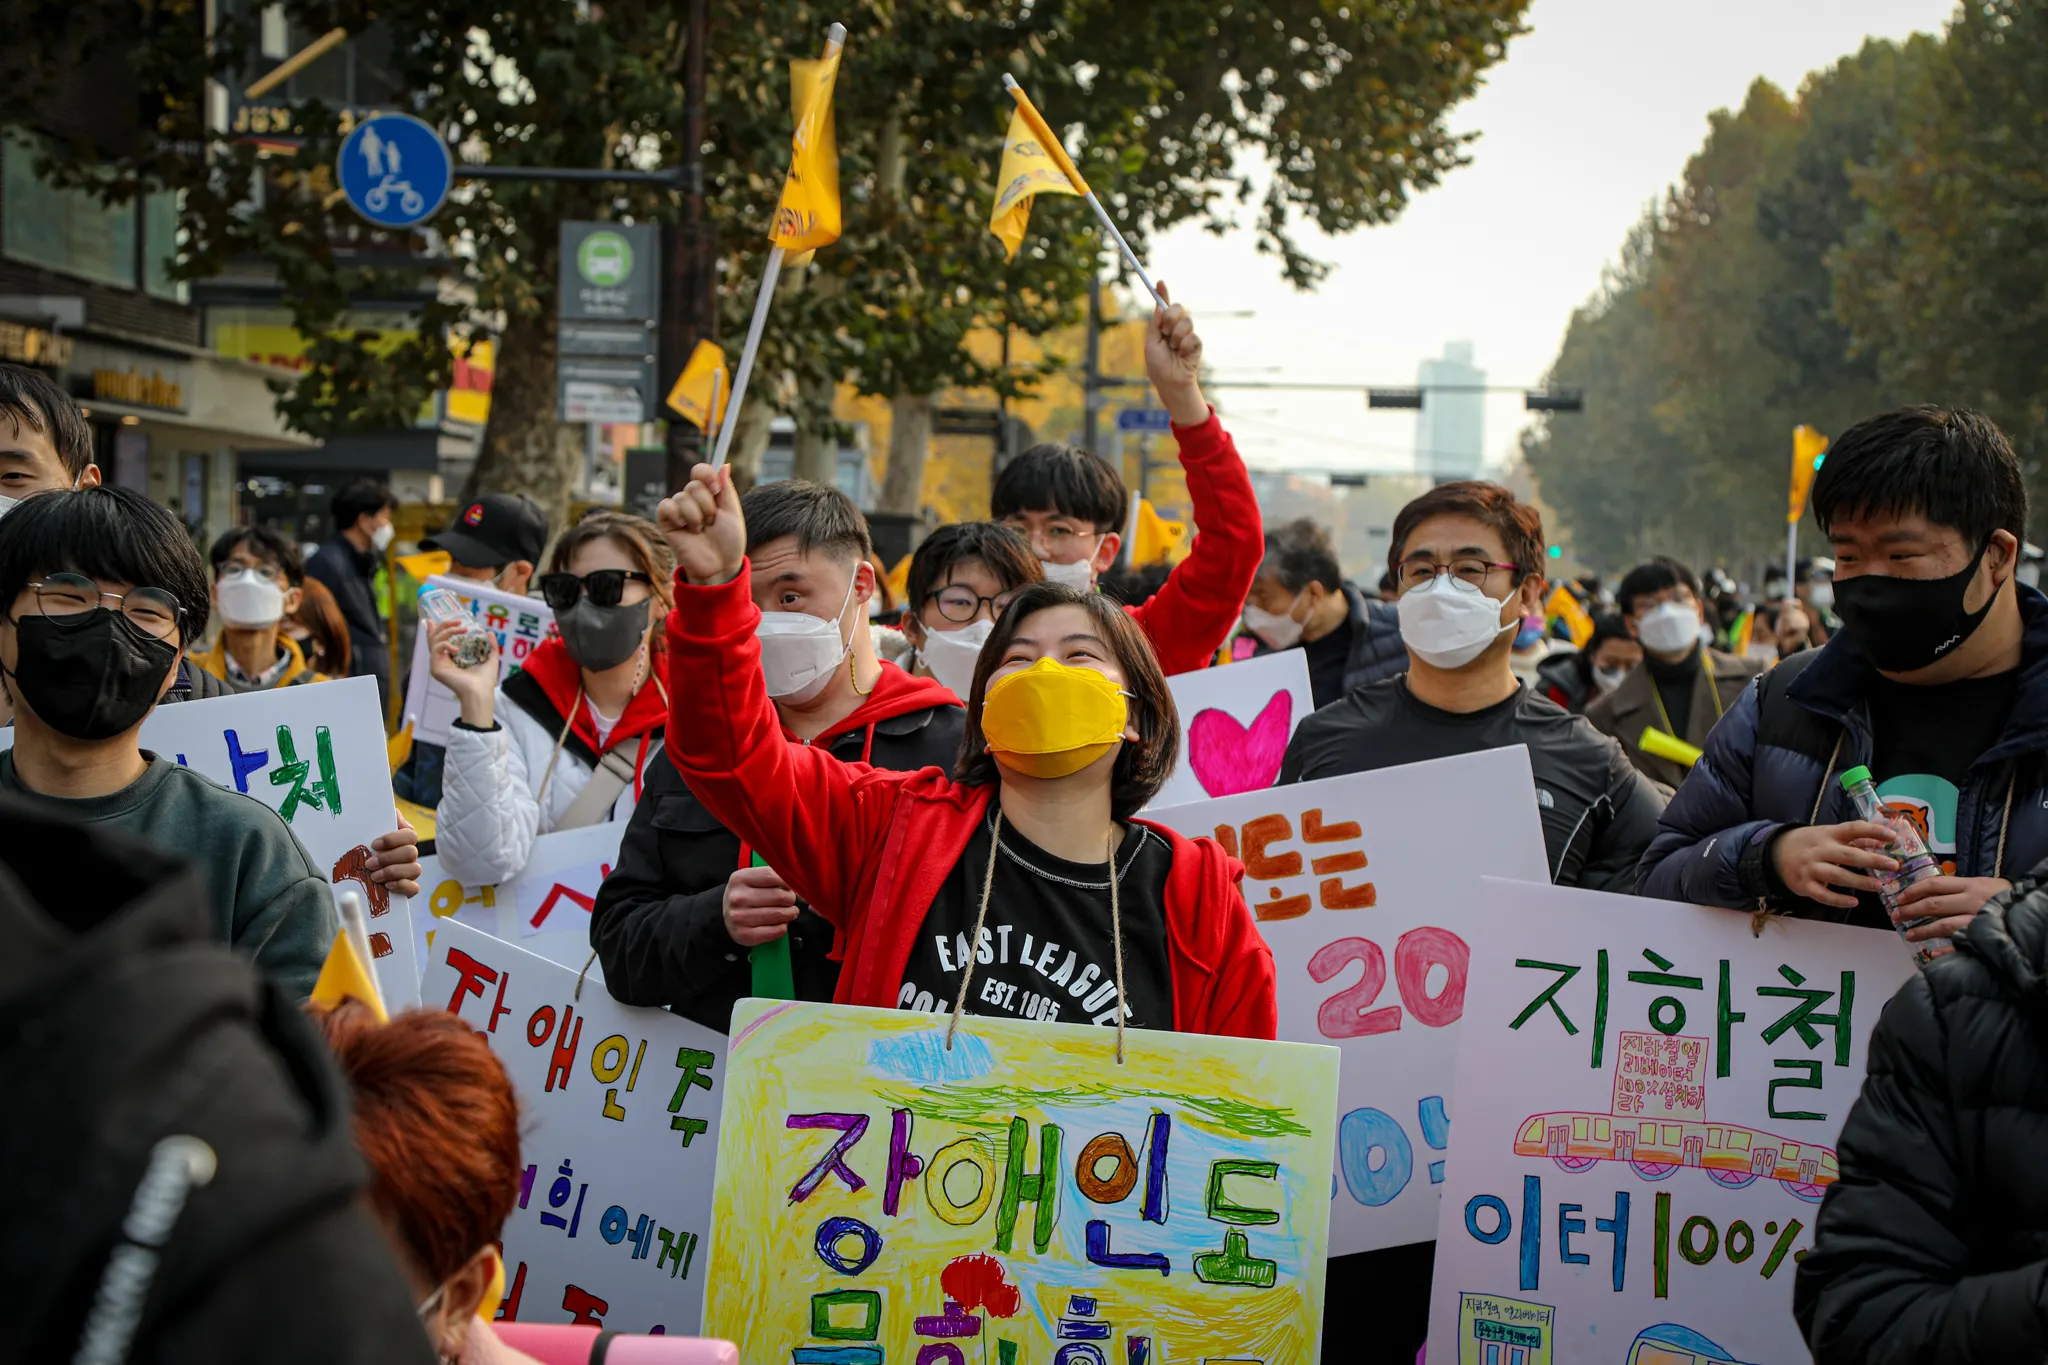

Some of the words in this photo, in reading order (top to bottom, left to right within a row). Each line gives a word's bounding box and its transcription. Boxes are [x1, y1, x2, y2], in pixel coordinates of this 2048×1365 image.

[935, 924, 1013, 972] EAST
[1019, 933, 1133, 1026] LEAGUE
[980, 976, 1018, 1012] EST.
[1018, 990, 1061, 1022] 1865
[1307, 926, 1471, 1038] 20
[1508, 947, 1856, 1121] 지하철
